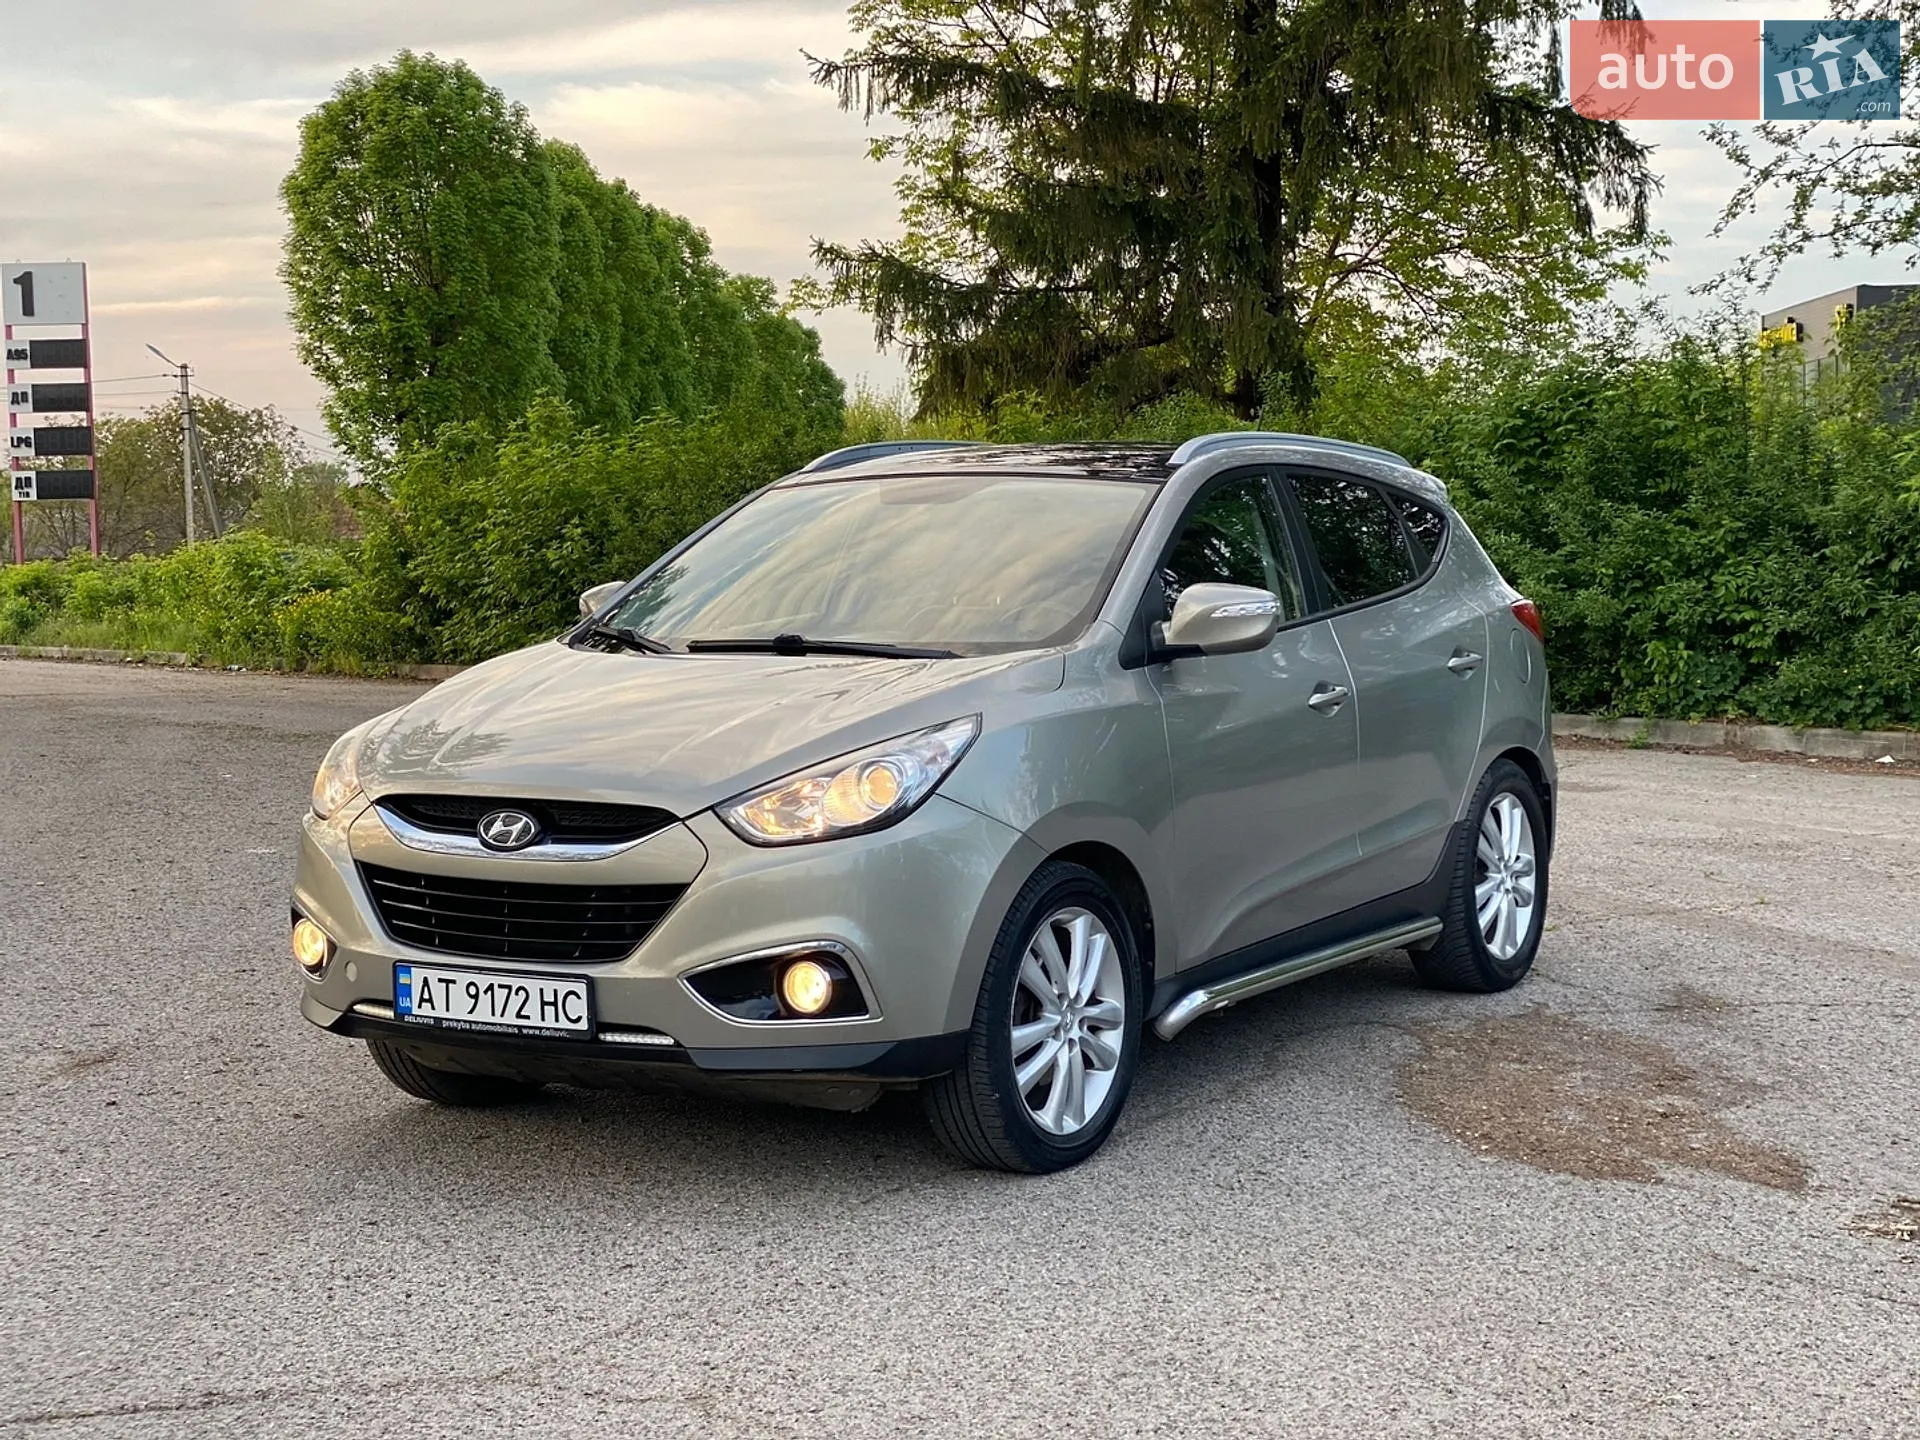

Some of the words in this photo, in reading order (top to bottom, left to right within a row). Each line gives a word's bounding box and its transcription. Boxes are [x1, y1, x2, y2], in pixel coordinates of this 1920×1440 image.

[13, 271, 35, 317] 1
[11, 436, 32, 448] LPG
[400, 997, 411, 1007] UA
[417, 976, 457, 1012] AT
[465, 981, 531, 1020] 9172
[539, 987, 583, 1024] HC
